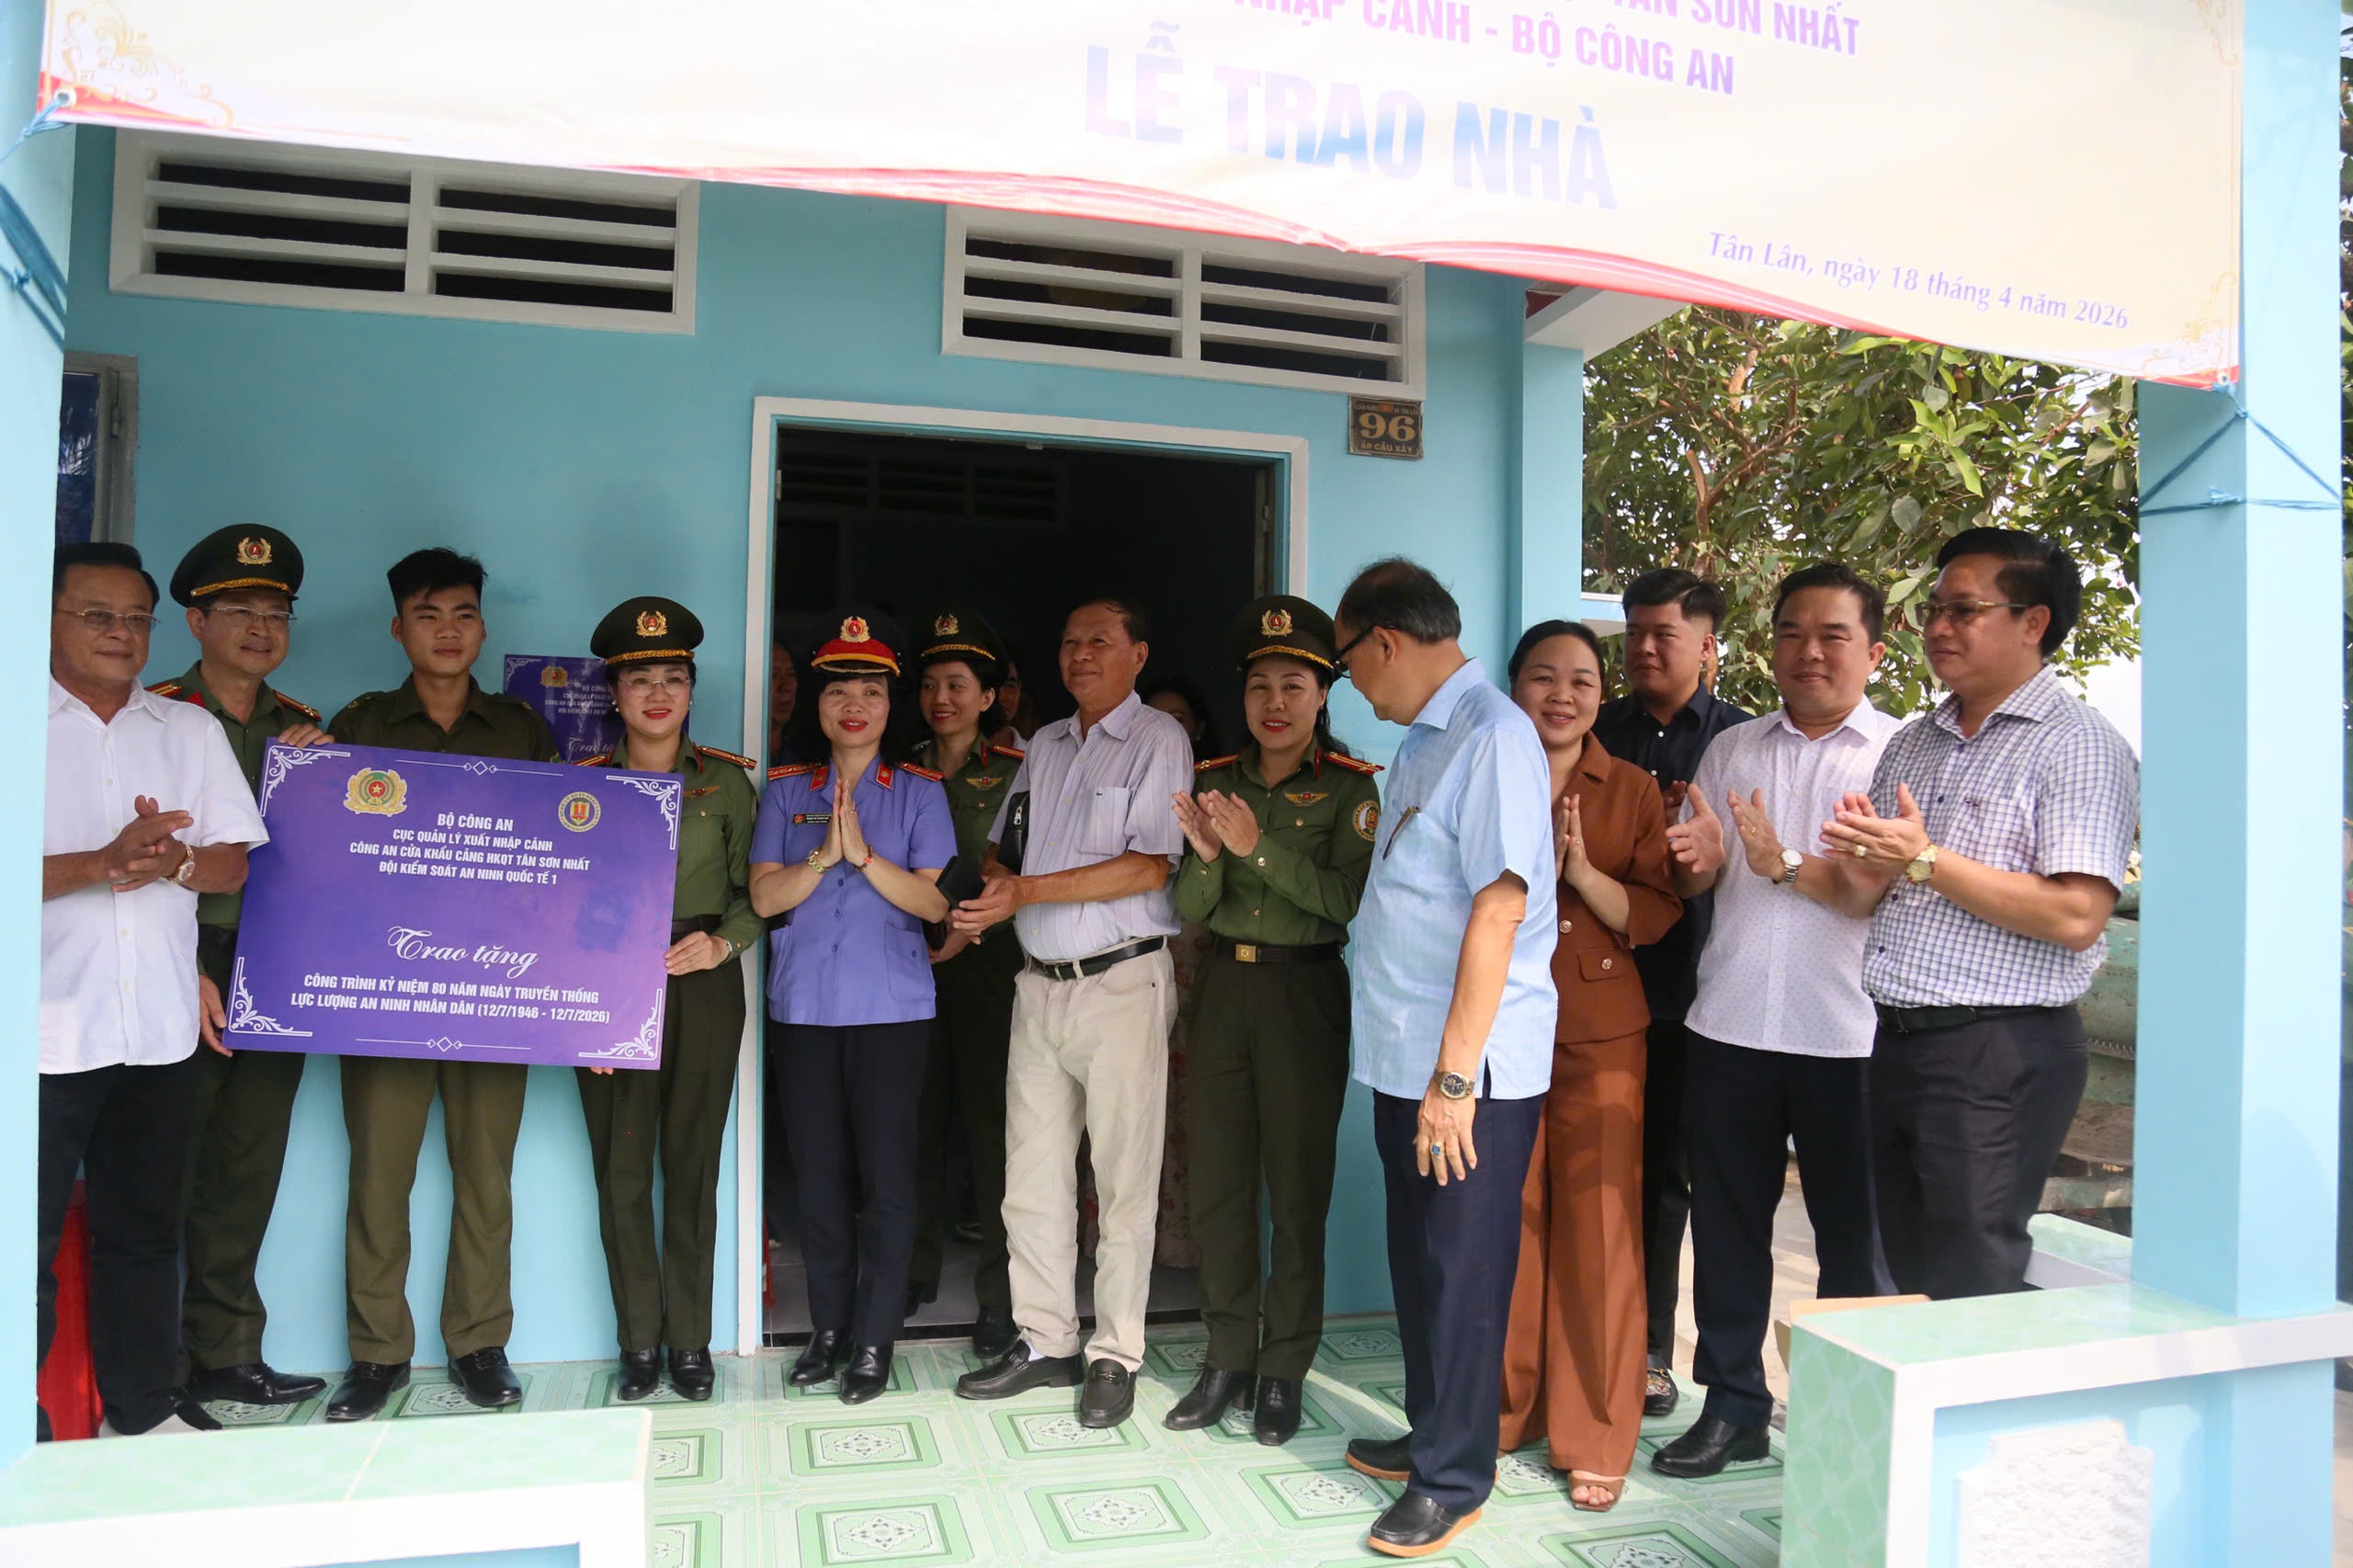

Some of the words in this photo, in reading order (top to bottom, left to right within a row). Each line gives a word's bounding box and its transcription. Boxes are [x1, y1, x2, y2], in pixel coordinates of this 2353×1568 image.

[1773, 1, 1860, 55] NHẤT
[1512, 11, 1562, 68] BỘ
[1574, 23, 1674, 82] CÔNG
[1686, 49, 1734, 96] AN
[1085, 20, 1185, 144] LỄ
[1213, 64, 1427, 179] TRAO
[1452, 104, 1619, 210] NHÀ
[1709, 231, 1754, 263] Tân
[1763, 242, 1814, 278] Lân,
[1824, 256, 1881, 291] ngày
[1891, 264, 1918, 292] 18
[1927, 272, 1992, 312] tháng
[1997, 286, 2013, 310] 4
[2019, 290, 2068, 319] năm
[2074, 300, 2130, 331] 2026
[1359, 412, 1415, 441] 96
[438, 812, 454, 829] BỘ
[458, 813, 493, 831] CÔNG
[494, 818, 514, 832] AN
[392, 829, 415, 842] CỤC
[417, 828, 446, 843] QUẢN
[449, 832, 461, 845] LÝ
[463, 832, 491, 846] XUẤT
[493, 835, 522, 851] NHẬP
[524, 836, 553, 851] CẢNH
[349, 841, 380, 855] CÔNG
[381, 845, 397, 857] AN
[400, 844, 422, 858] CỬA
[424, 845, 452, 860] KHẨU
[455, 847, 484, 863] CẢNG
[486, 853, 514, 866] HKQT
[516, 853, 536, 867] TÂN
[539, 856, 561, 869] SƠN
[563, 857, 590, 870] NHẤT
[379, 859, 397, 875] ĐỘI
[400, 859, 427, 875] KIỂM
[430, 864, 458, 878] SOÁT
[460, 868, 475, 879] AN
[477, 869, 504, 881] NINH
[506, 869, 534, 883] QUỐC
[537, 870, 550, 884] TẾ
[551, 874, 557, 885] 1
[387, 926, 469, 960] Trao
[472, 944, 539, 979] tặng
[303, 972, 338, 989] CÔNG
[341, 975, 377, 991] TRÌNH
[379, 975, 395, 992] KỶ
[397, 979, 429, 995] NIỆM
[431, 983, 447, 995] 80
[449, 982, 477, 997] NĂM
[480, 983, 512, 999] NGÀY
[562, 987, 599, 1004] THỐNG
[290, 993, 314, 1009] LỰC
[317, 993, 358, 1010] LƯỢNG
[360, 997, 378, 1010] AN
[380, 998, 411, 1012] NINH
[413, 998, 447, 1014] NHÂN
[449, 1000, 474, 1016] DÂN
[478, 1004, 539, 1019] (12/7/1946
[551, 1007, 610, 1024] 12/7/2026)
